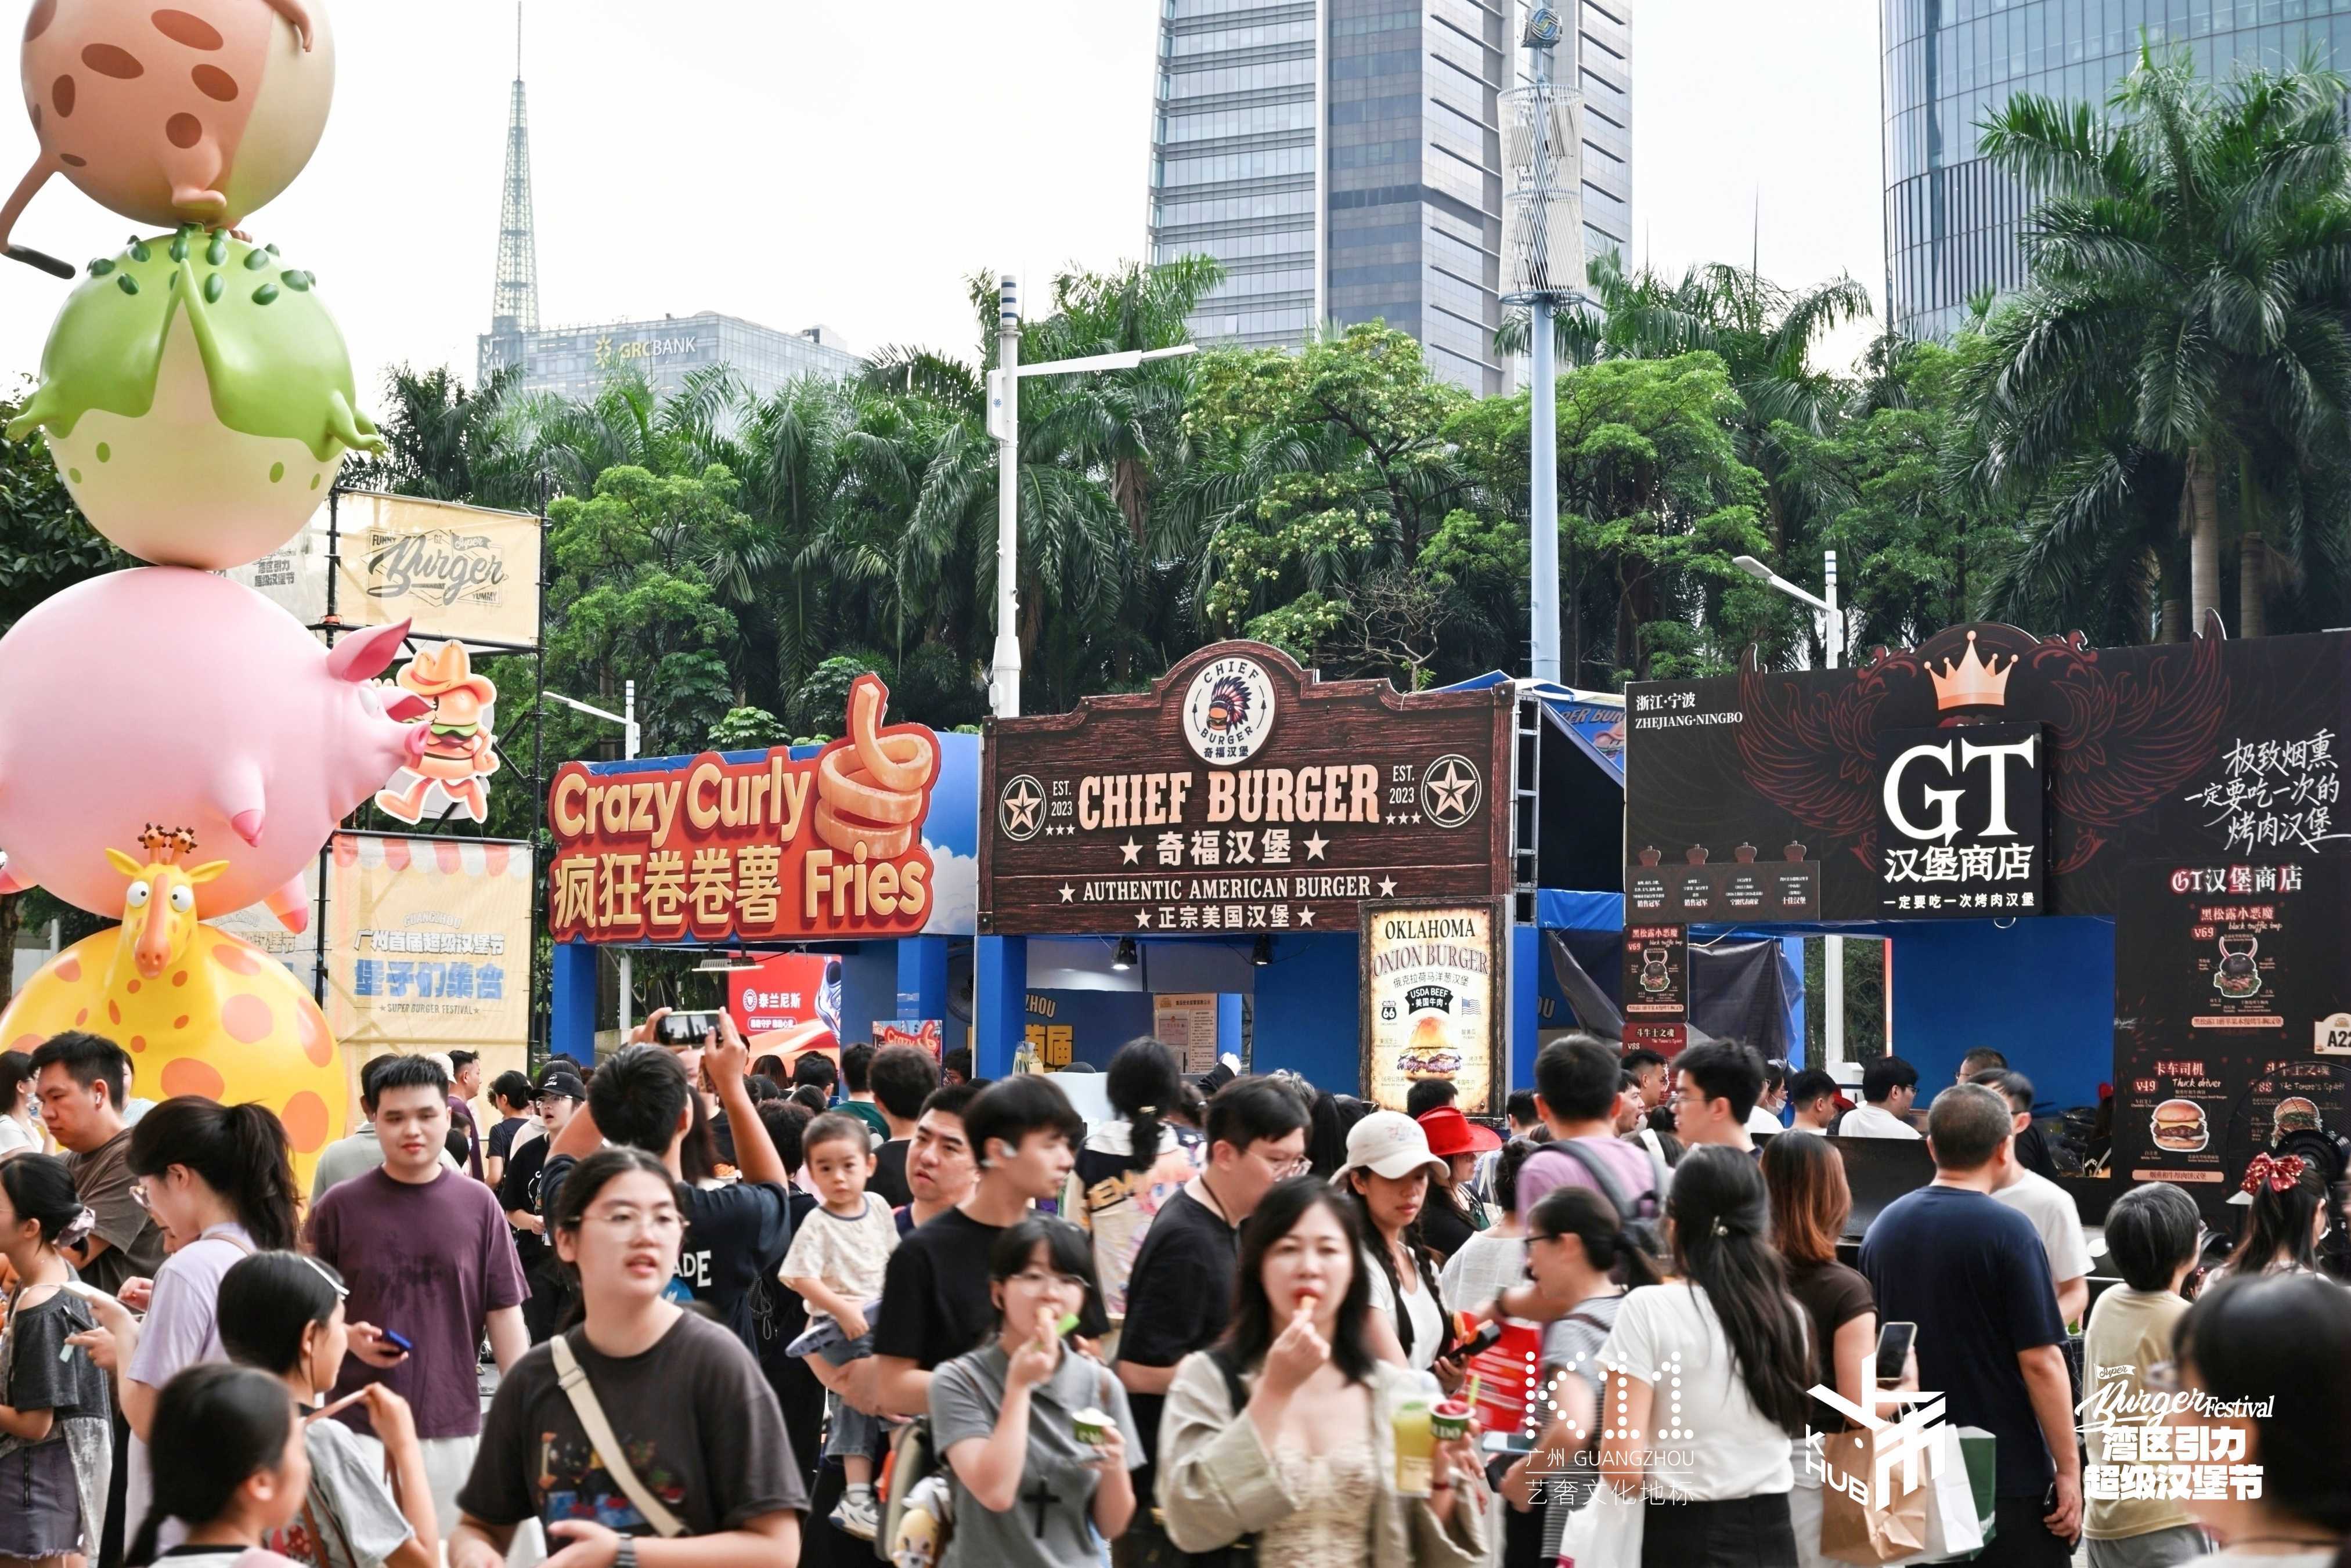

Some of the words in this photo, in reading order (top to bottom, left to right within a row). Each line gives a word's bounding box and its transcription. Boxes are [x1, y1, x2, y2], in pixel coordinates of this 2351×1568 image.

[619, 336, 696, 359] GRCBANK
[367, 534, 505, 606] Burger
[473, 590, 497, 602] YUMMY
[1204, 661, 1259, 684] CHIEF
[1636, 692, 1696, 711] 浙江·宁波
[1635, 711, 1743, 730] ZHEJIANG·NINGBO
[1200, 725, 1253, 745] BURGER
[1204, 746, 1249, 758] 奇福汉堡
[2222, 728, 2339, 778] 极致烟熏
[1392, 764, 1415, 782] EST.
[1052, 781, 1072, 796] EST.
[1077, 771, 1192, 830] CHIEF
[1207, 764, 1380, 823] BURGER
[1389, 787, 1415, 804] 2023
[1883, 734, 2035, 847] GT
[2184, 772, 2341, 827] 一定要吃一次的
[554, 772, 683, 848] Crazy
[687, 756, 812, 843] Curly
[1051, 801, 1073, 817] 2023
[2223, 806, 2351, 857] 烤肉汉堡
[1156, 828, 1292, 866] 奇福汉堡
[1883, 843, 2035, 883] 汉堡商店
[554, 844, 782, 930] 疯狂卷卷薯
[806, 840, 927, 919] Fries
[1083, 879, 1182, 901] AUTHENTIC
[1188, 877, 1289, 899] AMERICAN
[1295, 875, 1371, 898] BURGER
[2172, 865, 2303, 893] GT汉堡商店
[1884, 891, 2035, 910] 一定要吃一次烤肉汉堡
[403, 911, 462, 930] GUANGZHOU
[1158, 903, 1290, 929] 正宗美国汉堡
[2201, 906, 2274, 922] 黑松露小恶魔
[1385, 918, 1476, 940] OKLAHOMA
[354, 929, 505, 956] 广州首届超级汉堡节
[1372, 945, 1422, 978] ONION
[1425, 944, 1490, 976] BURGER
[1393, 971, 1469, 989] 俄克拉荷马洋葱汉堡
[1410, 988, 1430, 998] USDA
[1430, 988, 1449, 998] BEEF
[1415, 998, 1444, 1008] 美国牛肉
[387, 1003, 410, 1013] SUPER
[411, 1003, 440, 1014] BURGER
[442, 1005, 473, 1015] FESTIVAL
[1383, 1008, 1396, 1018] 66
[2154, 1061, 2205, 1076] 卡车司机
